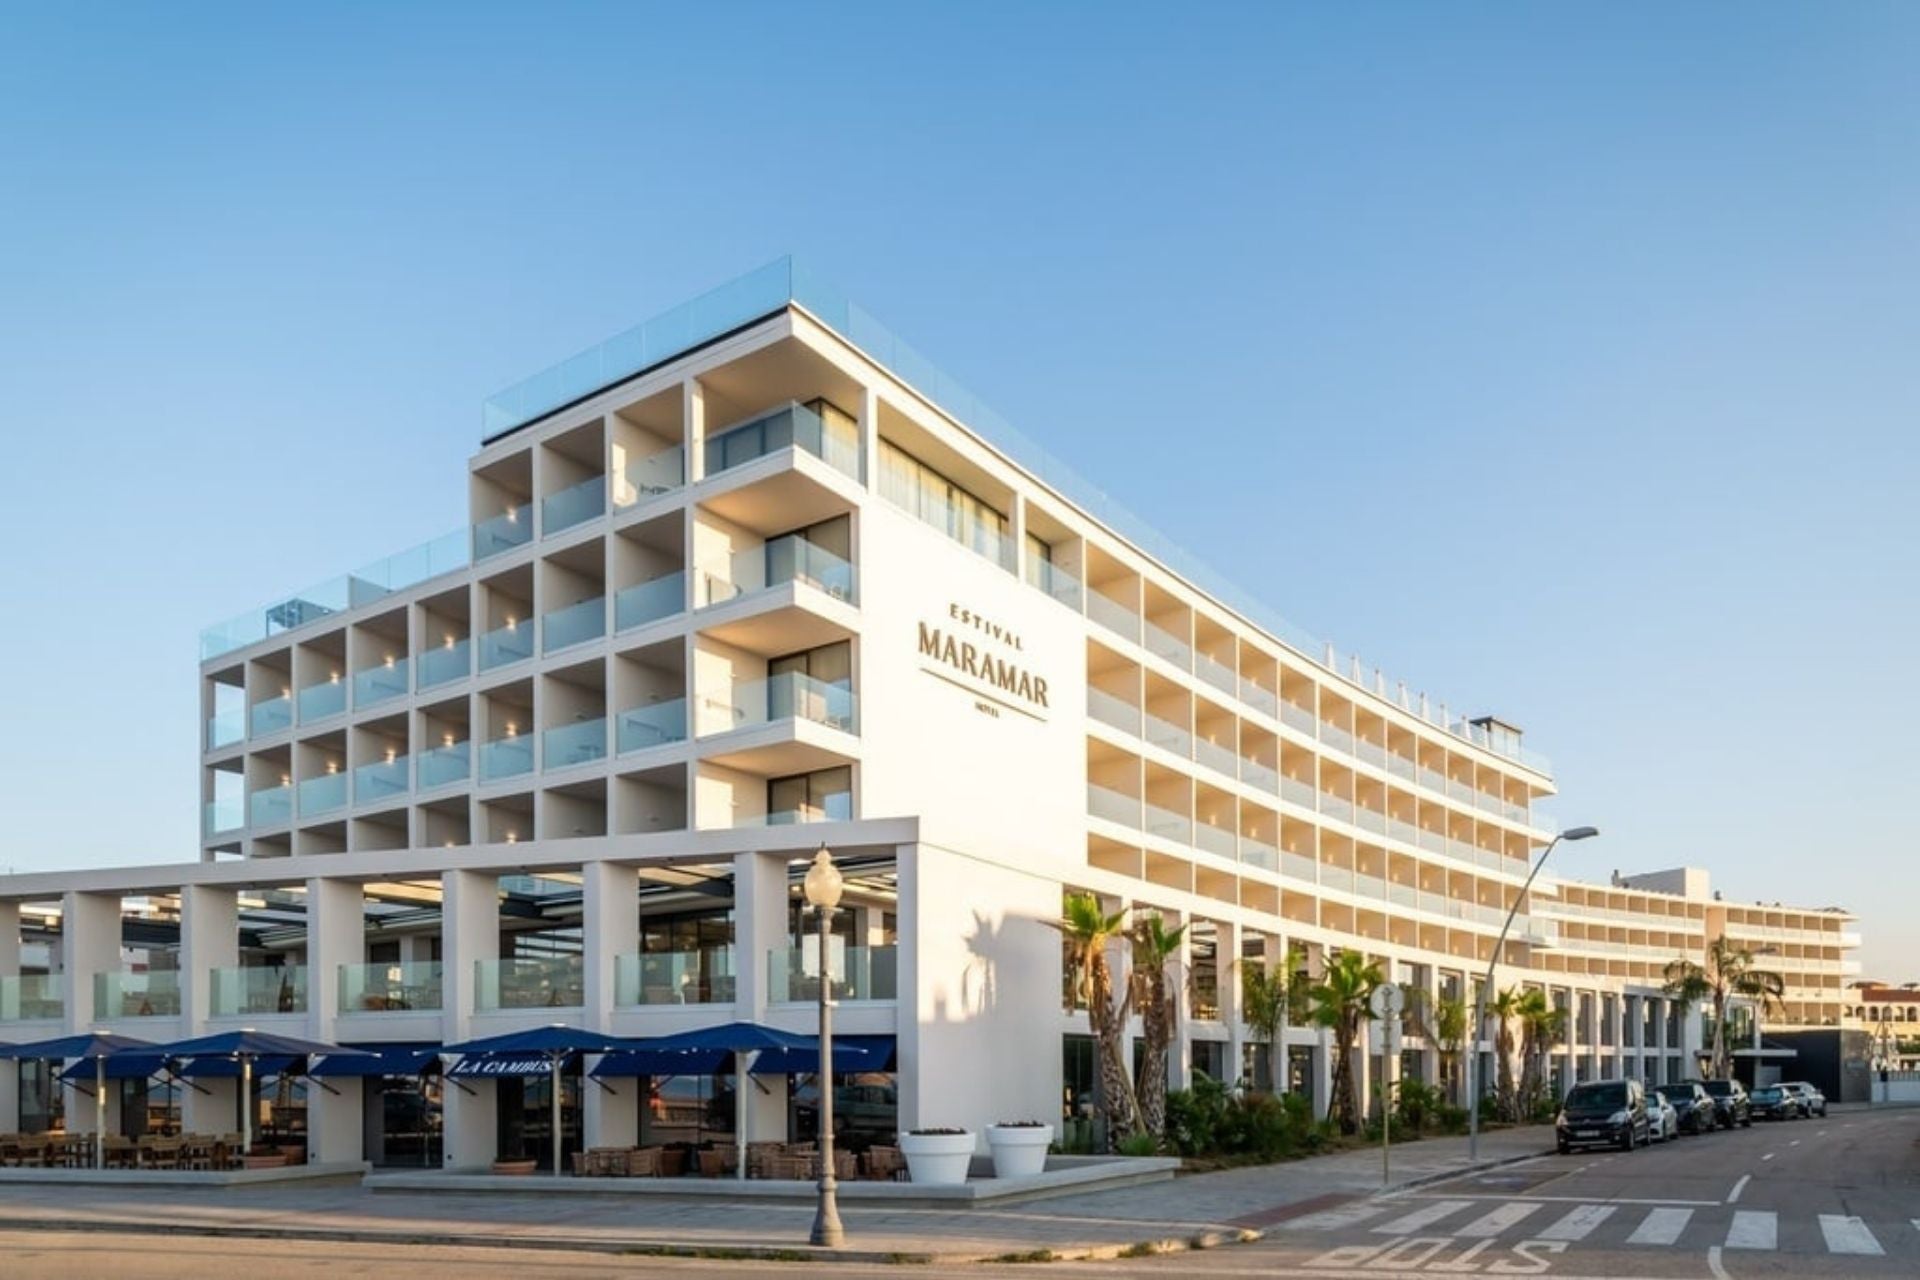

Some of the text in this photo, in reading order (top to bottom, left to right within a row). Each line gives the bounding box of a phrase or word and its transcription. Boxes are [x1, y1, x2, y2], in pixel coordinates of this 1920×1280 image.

[949, 602, 1023, 652] ESTIVAL
[918, 620, 1049, 708] MARAMAR
[454, 1060, 481, 1073] LA
[1300, 1236, 1571, 1274] STOP
